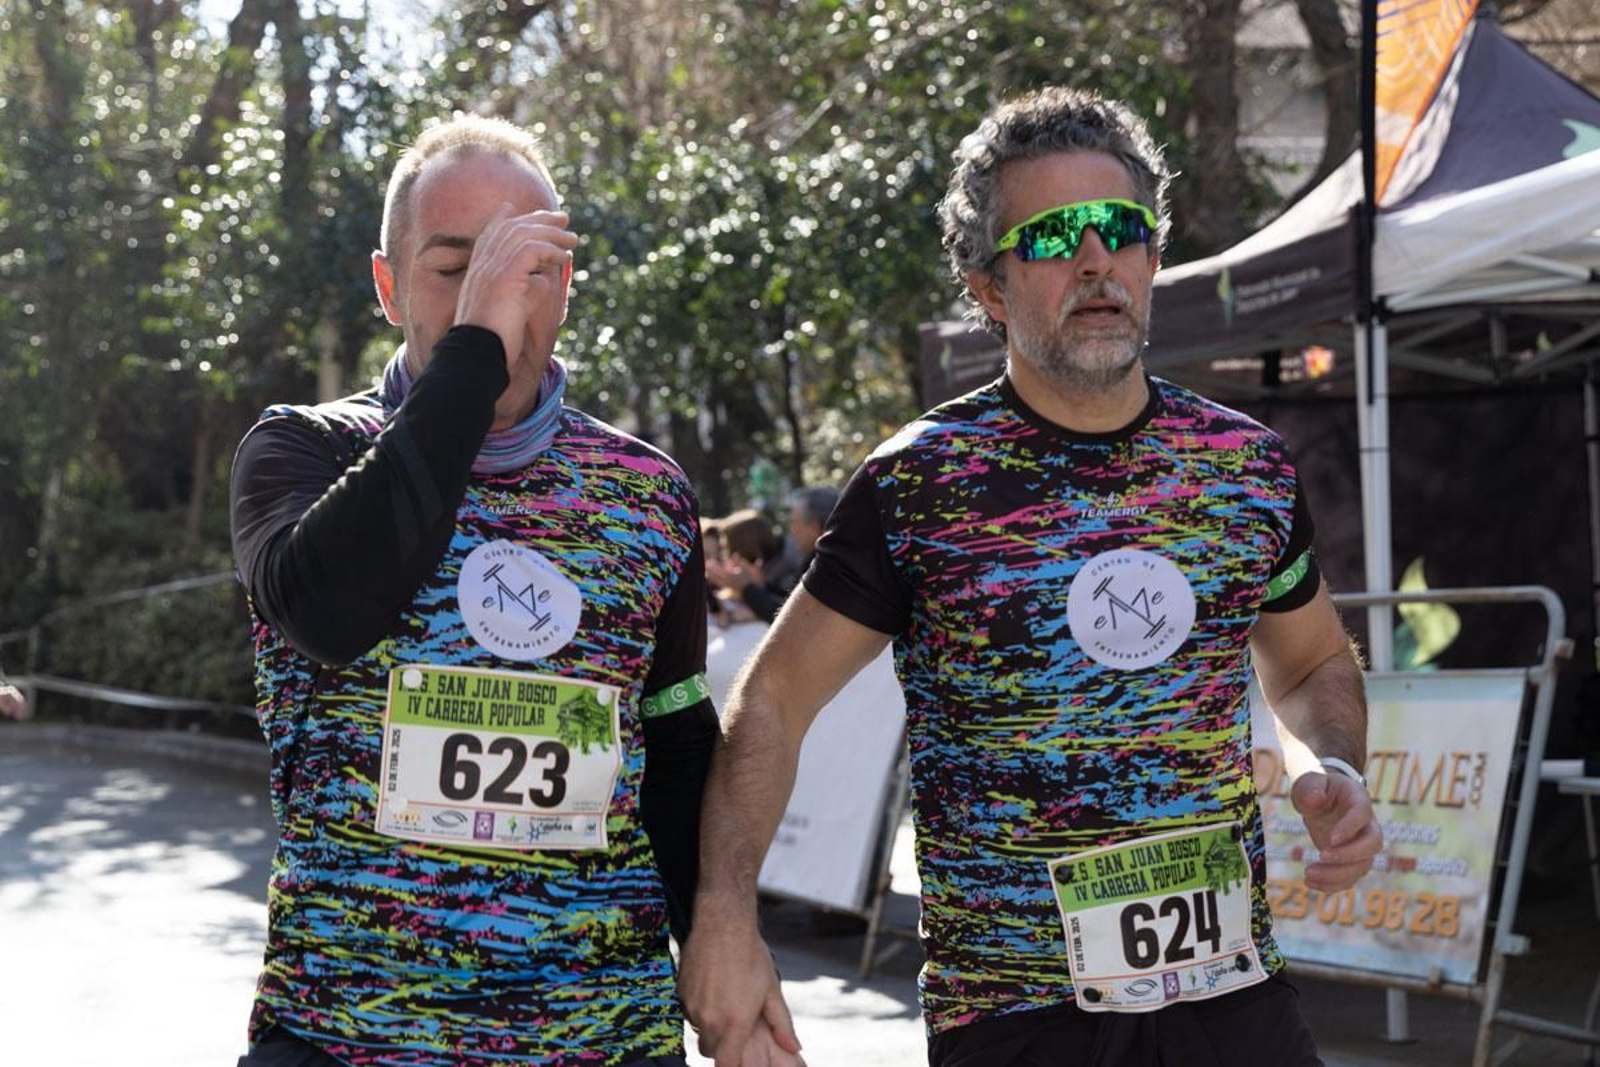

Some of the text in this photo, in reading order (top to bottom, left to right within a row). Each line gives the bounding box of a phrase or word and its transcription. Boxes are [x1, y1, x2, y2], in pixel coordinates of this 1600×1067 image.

[1081, 505, 1149, 518] TEAMERGY
[1092, 557, 1156, 576] CENTRO DE
[479, 620, 561, 650] ENTRENAMIENTO
[1094, 626, 1176, 660] ENTRENAMIENTO
[437, 674, 467, 697] SAN
[472, 678, 512, 701] JUAN
[517, 681, 557, 706] BOSCO
[407, 695, 545, 727] IV CARRERA POPULAR
[439, 732, 570, 808] 623
[1094, 852, 1125, 877] SAN
[1129, 843, 1166, 869] JUAN
[1166, 836, 1202, 862] BOSCO
[1073, 860, 1198, 902] IV CARRERA POPULAR
[1119, 890, 1222, 970] 624
[1410, 892, 1462, 938] 28
